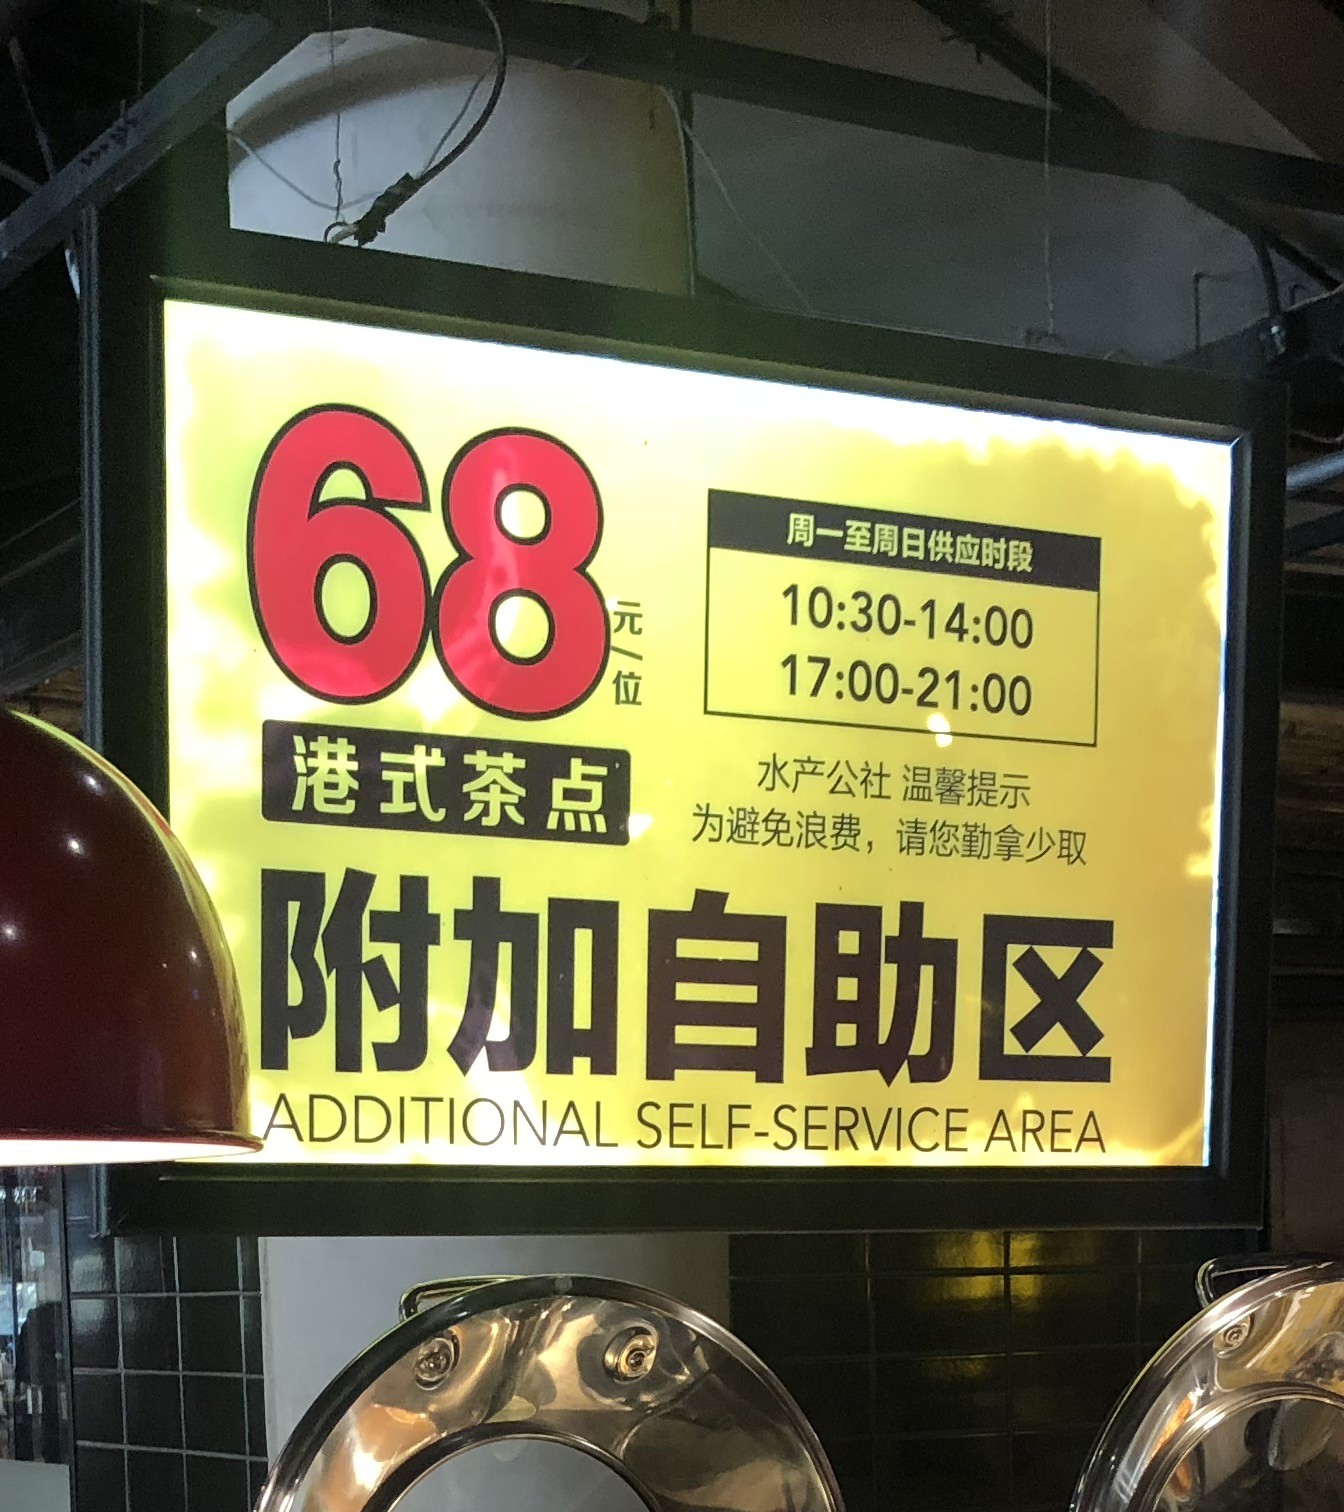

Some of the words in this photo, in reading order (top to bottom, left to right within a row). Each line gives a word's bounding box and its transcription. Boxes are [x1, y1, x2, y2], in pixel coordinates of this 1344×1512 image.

[246, 402, 612, 722] 68
[786, 512, 1034, 573] 周一至周日供应时段
[782, 583, 1034, 650] 10:30-14:00
[780, 653, 1033, 717] 17:00-21:00
[291, 734, 608, 834] 港式茶点
[756, 752, 892, 801] 水产公社
[901, 763, 1032, 810] 温馨提示
[691, 802, 1089, 867] 为避免浪费，请您勤拿少取
[260, 867, 1115, 1088] 附加自助区
[262, 1092, 619, 1148] ADDITIONAL
[636, 1101, 969, 1152] SELF-SERVICE
[983, 1108, 1107, 1154] AREA
